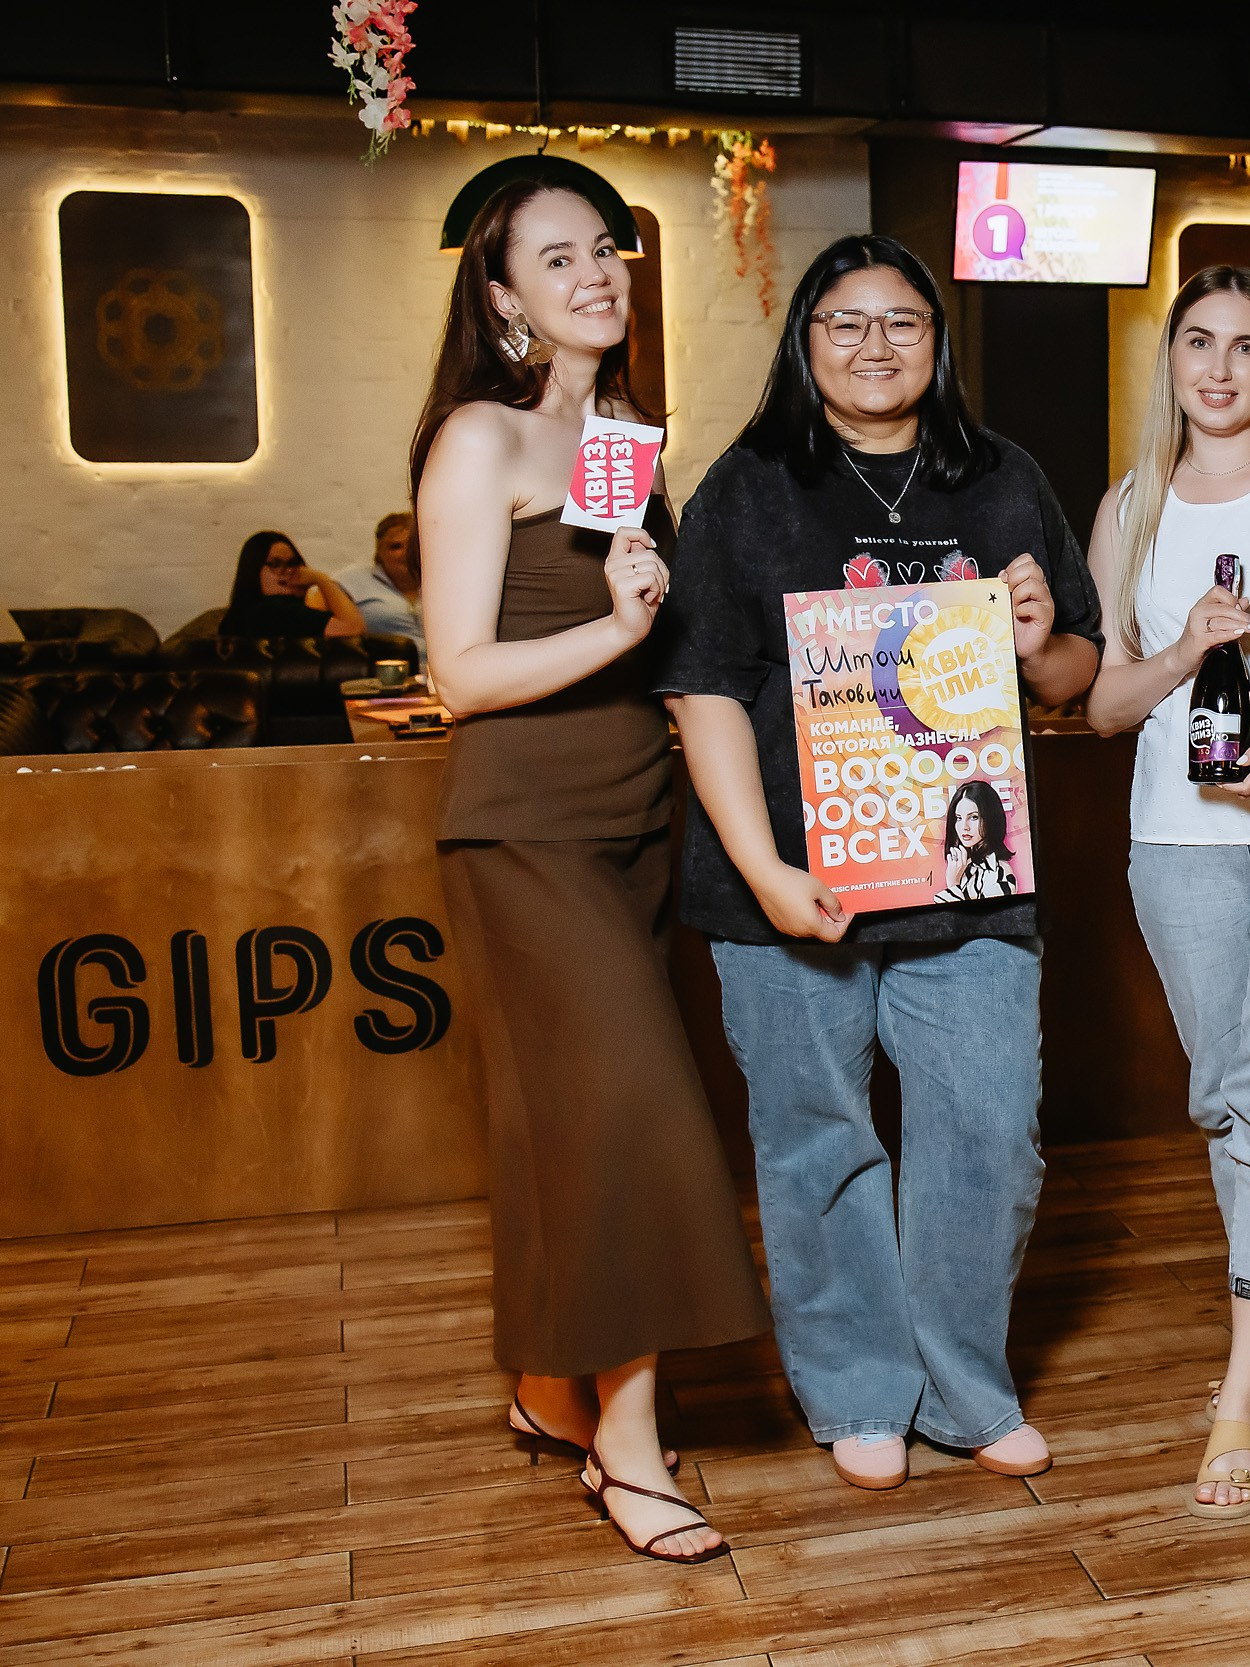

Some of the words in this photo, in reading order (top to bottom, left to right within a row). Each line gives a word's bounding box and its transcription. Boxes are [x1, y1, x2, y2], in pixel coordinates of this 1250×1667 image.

[986, 214, 1009, 253] 1
[854, 536, 896, 544] believe
[898, 537, 909, 545] in
[912, 538, 959, 547] yourself
[826, 599, 940, 633] МЕСТО
[801, 678, 905, 709] Таковичи
[810, 716, 900, 737] КОМАНДЕ,
[812, 735, 891, 756] КОТОРАЯ
[893, 727, 981, 749] РАЗНЕСЛА
[820, 824, 930, 868] ВСЕХ
[875, 879, 901, 889] ЛЕТНИЕ
[901, 877, 921, 885] ХИТЫ
[37, 916, 452, 1077] GIPS
